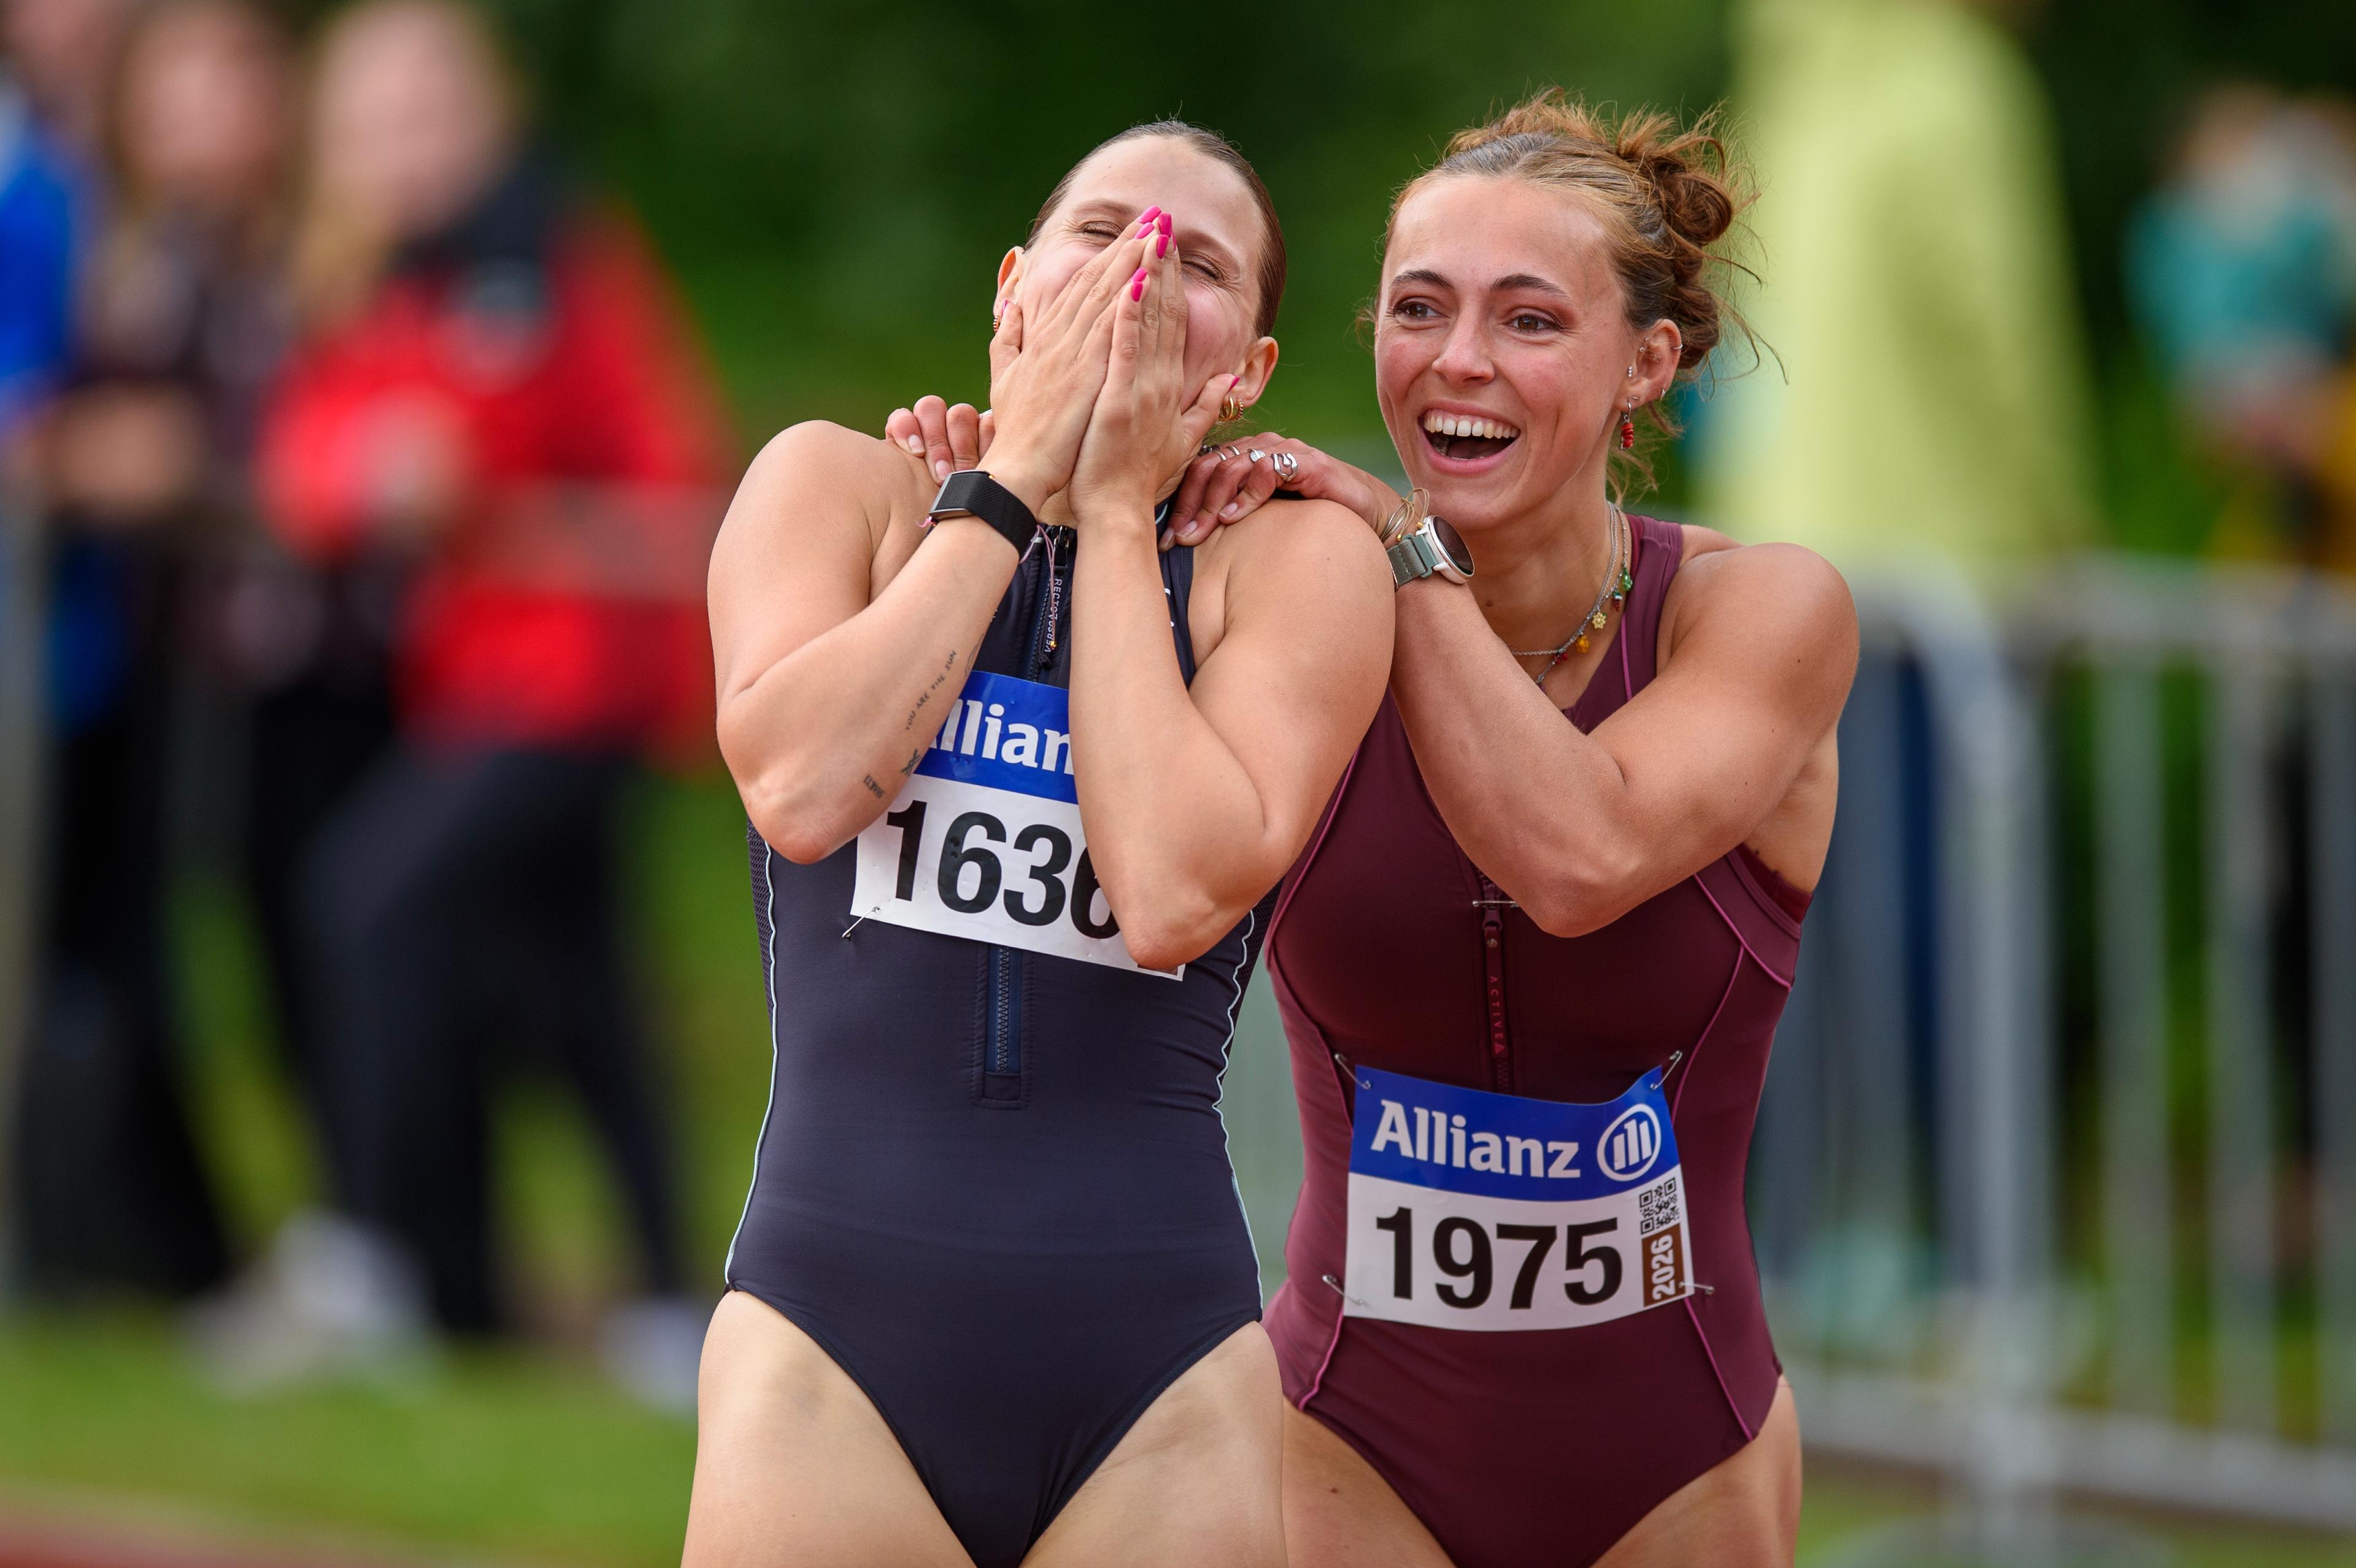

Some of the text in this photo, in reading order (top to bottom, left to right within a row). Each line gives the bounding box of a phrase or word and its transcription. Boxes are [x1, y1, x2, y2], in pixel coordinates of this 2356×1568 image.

[916, 691, 930, 709] ARE
[931, 673, 946, 690] THE
[945, 650, 957, 671] SUN
[930, 698, 1074, 775] llian
[1489, 975, 1504, 1040] ACTIVE
[1371, 1099, 1581, 1179] Allianz
[1376, 1205, 1623, 1311] 1975
[1652, 1235, 1674, 1300] 2026
